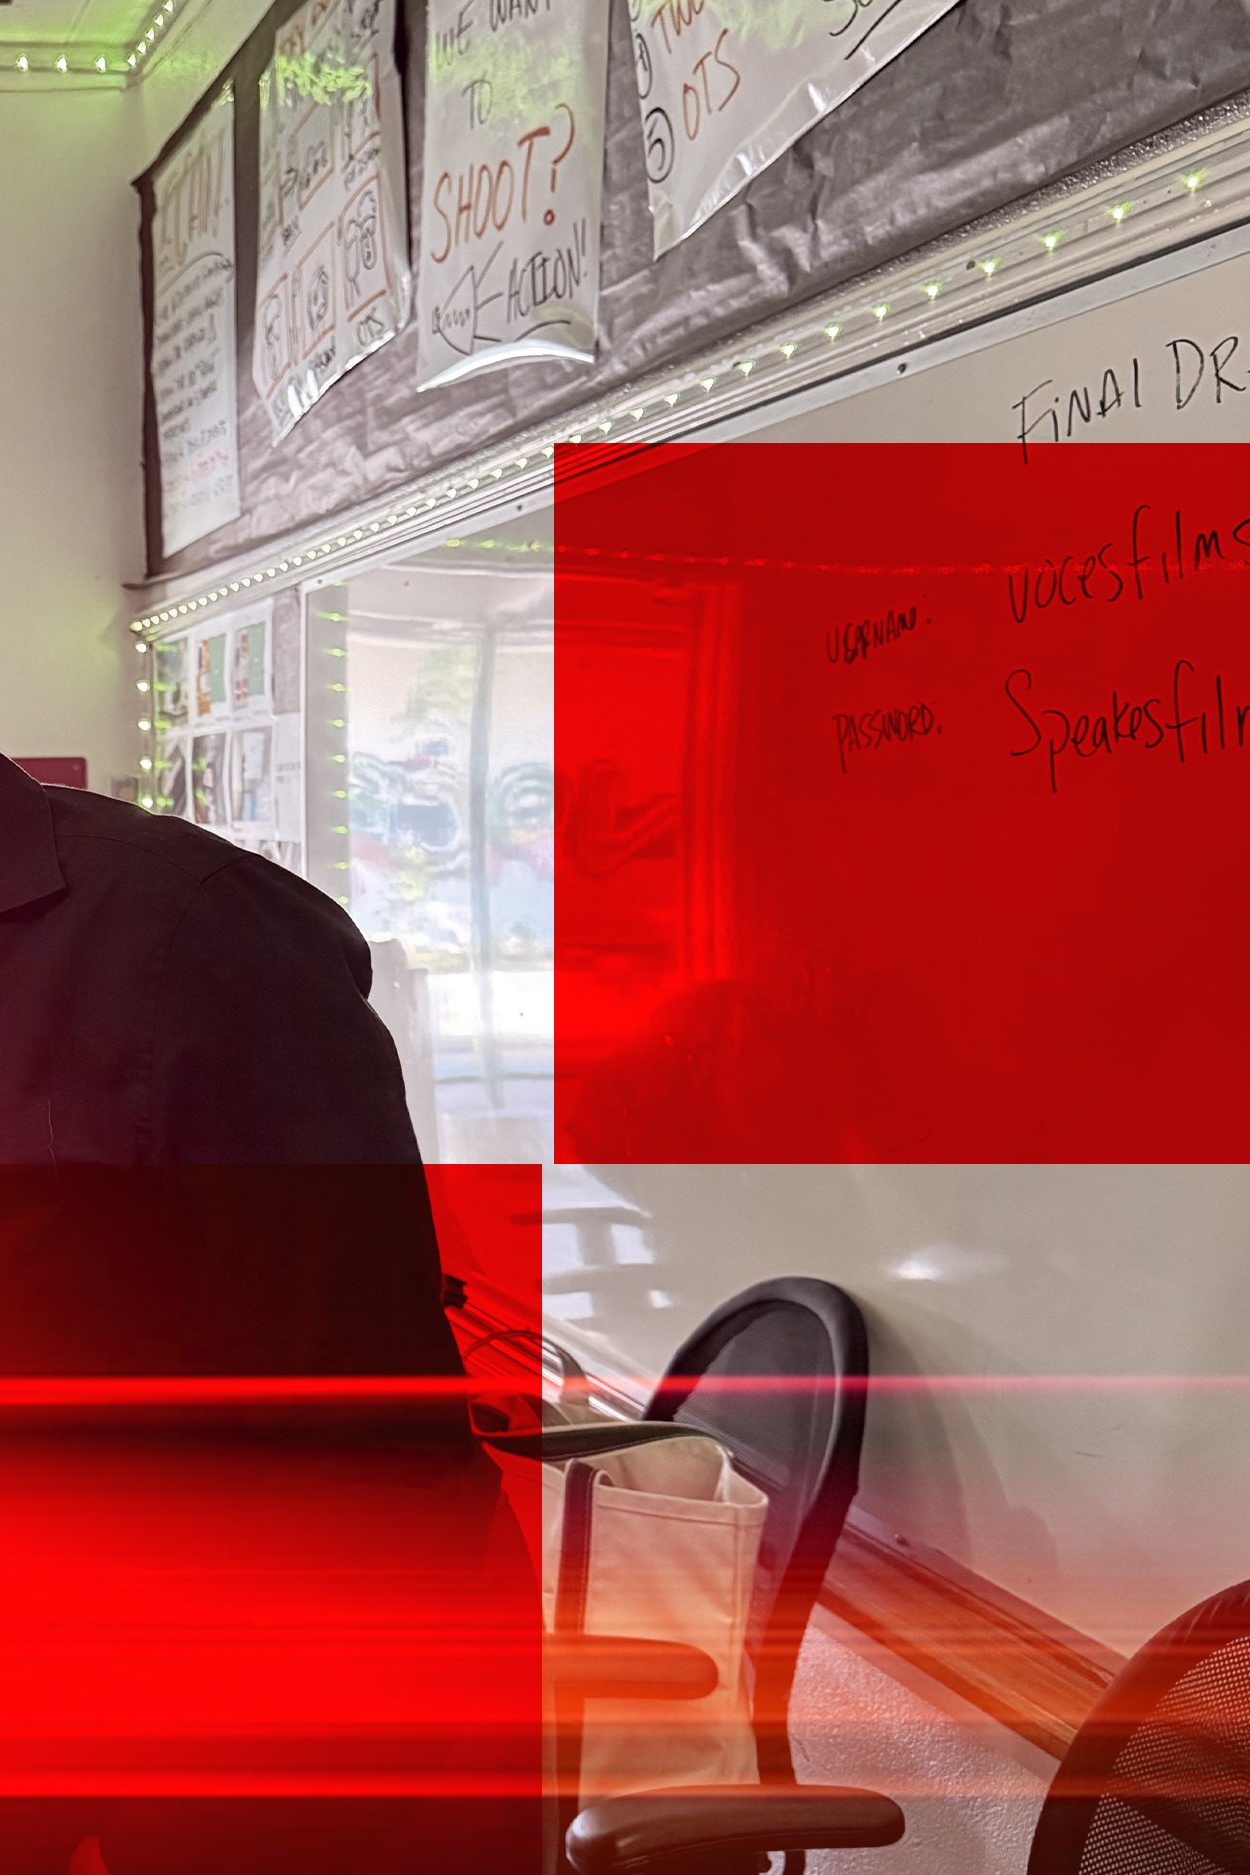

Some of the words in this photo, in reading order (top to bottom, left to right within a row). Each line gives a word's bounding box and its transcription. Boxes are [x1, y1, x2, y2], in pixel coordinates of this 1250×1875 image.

[461, 68, 494, 130] TO
[683, 28, 741, 141] OTS
[430, 103, 575, 264] SHOOT?
[1165, 335, 1250, 411] DR
